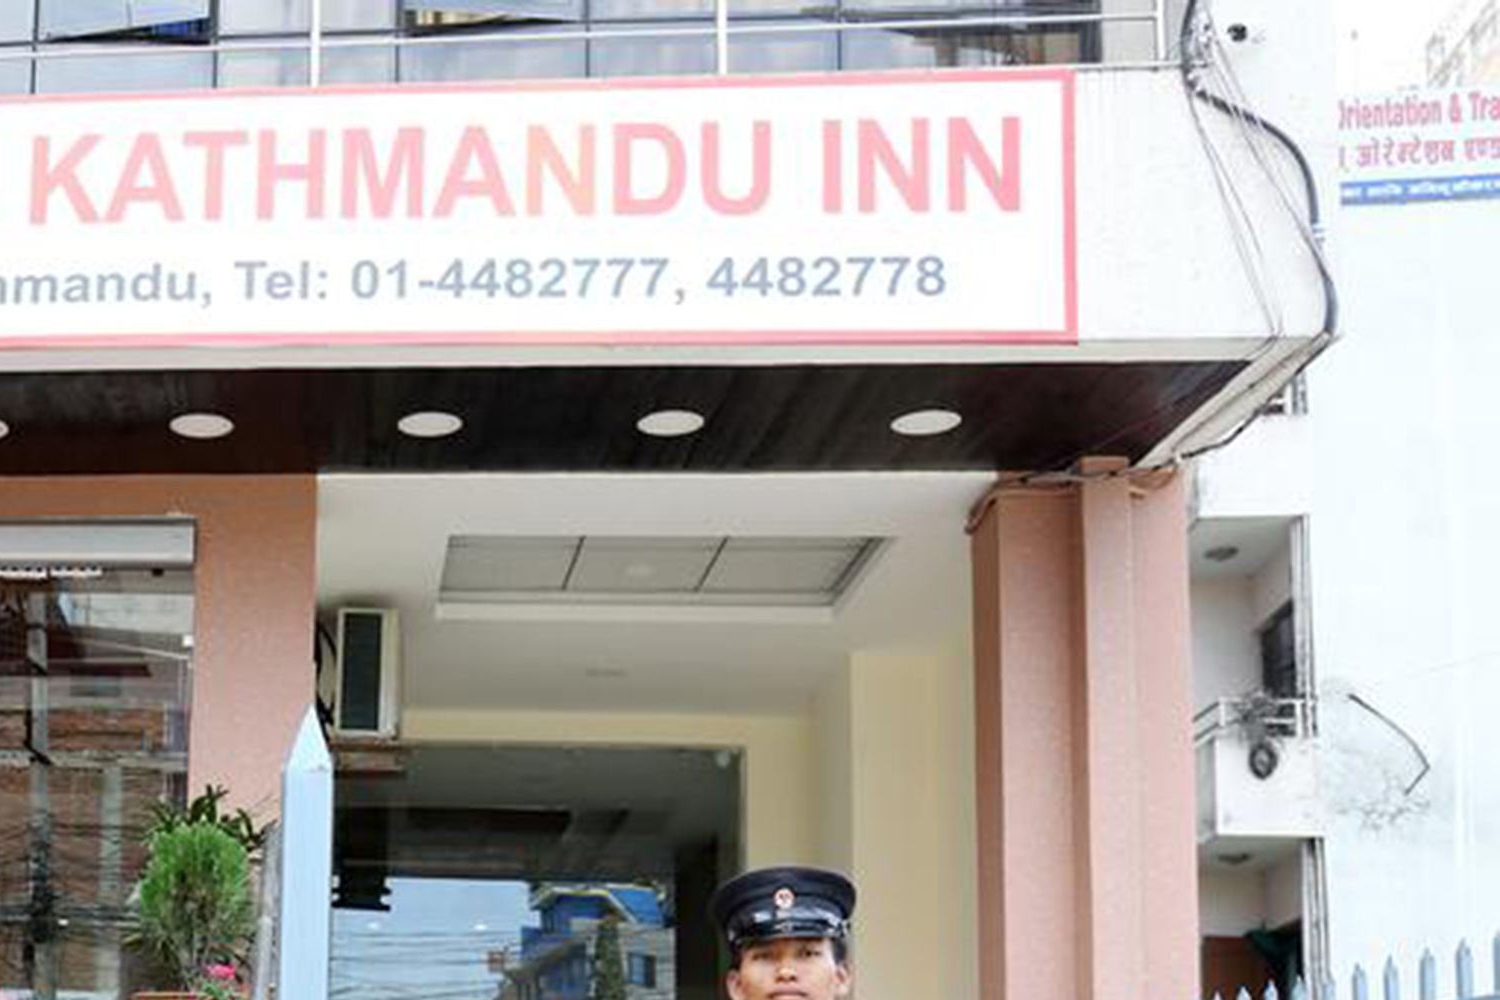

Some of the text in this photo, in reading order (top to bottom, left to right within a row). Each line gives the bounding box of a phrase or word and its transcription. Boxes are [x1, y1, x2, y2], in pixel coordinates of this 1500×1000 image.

[1449, 92, 1463, 123] &
[29, 121, 772, 226] KATHMANDU
[821, 116, 1021, 213] INN
[234, 260, 329, 301] Tel:
[349, 256, 687, 306] 01-4482777,
[705, 255, 947, 298] 4482778
